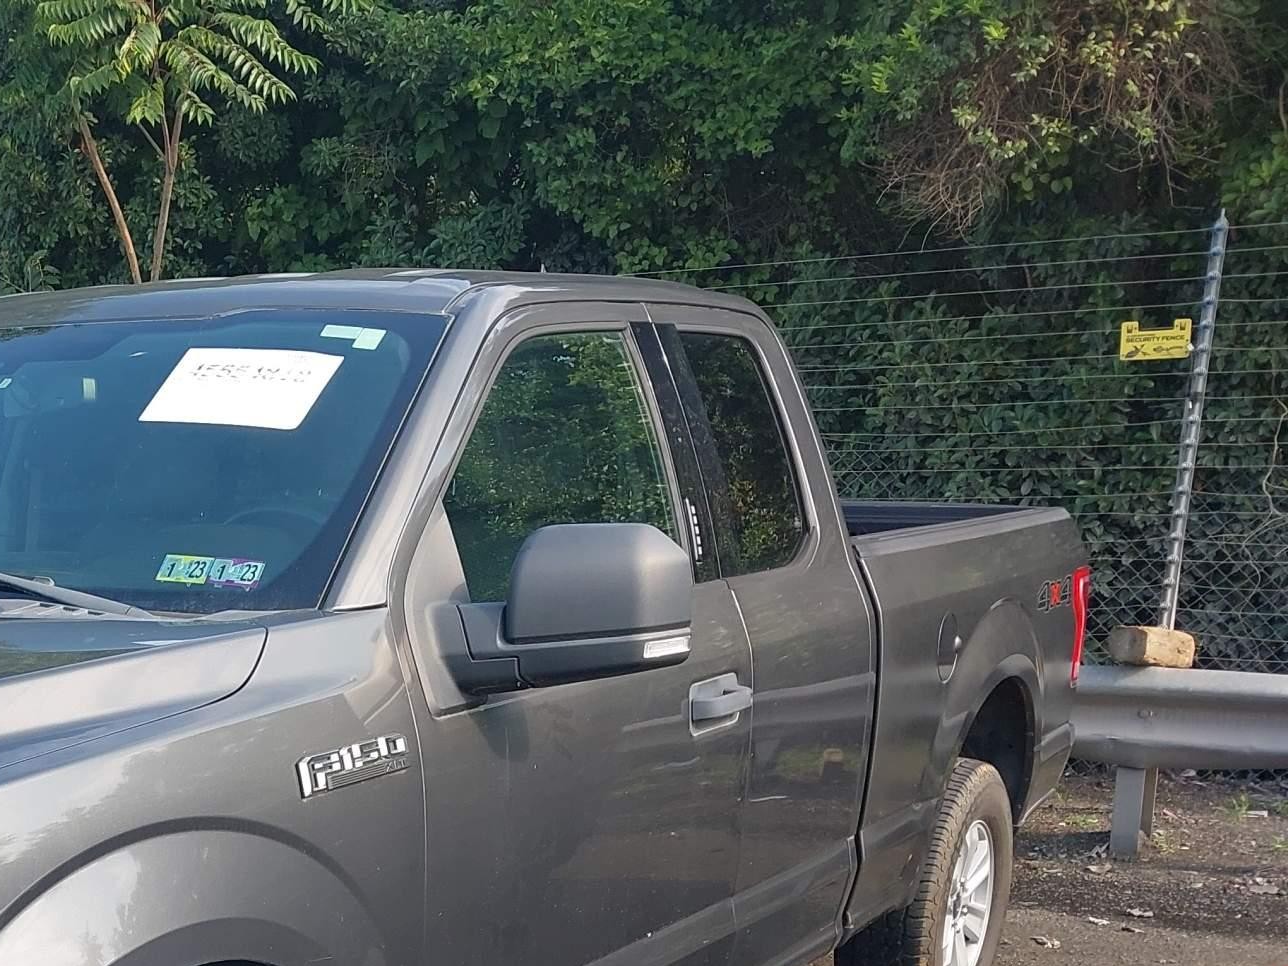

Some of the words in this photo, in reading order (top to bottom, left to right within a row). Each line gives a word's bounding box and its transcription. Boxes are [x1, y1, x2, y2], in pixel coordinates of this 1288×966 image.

[1125, 335, 1160, 344] SECURITY
[1161, 334, 1186, 342] FENCE
[188, 561, 207, 579] 23
[240, 564, 258, 582] 23
